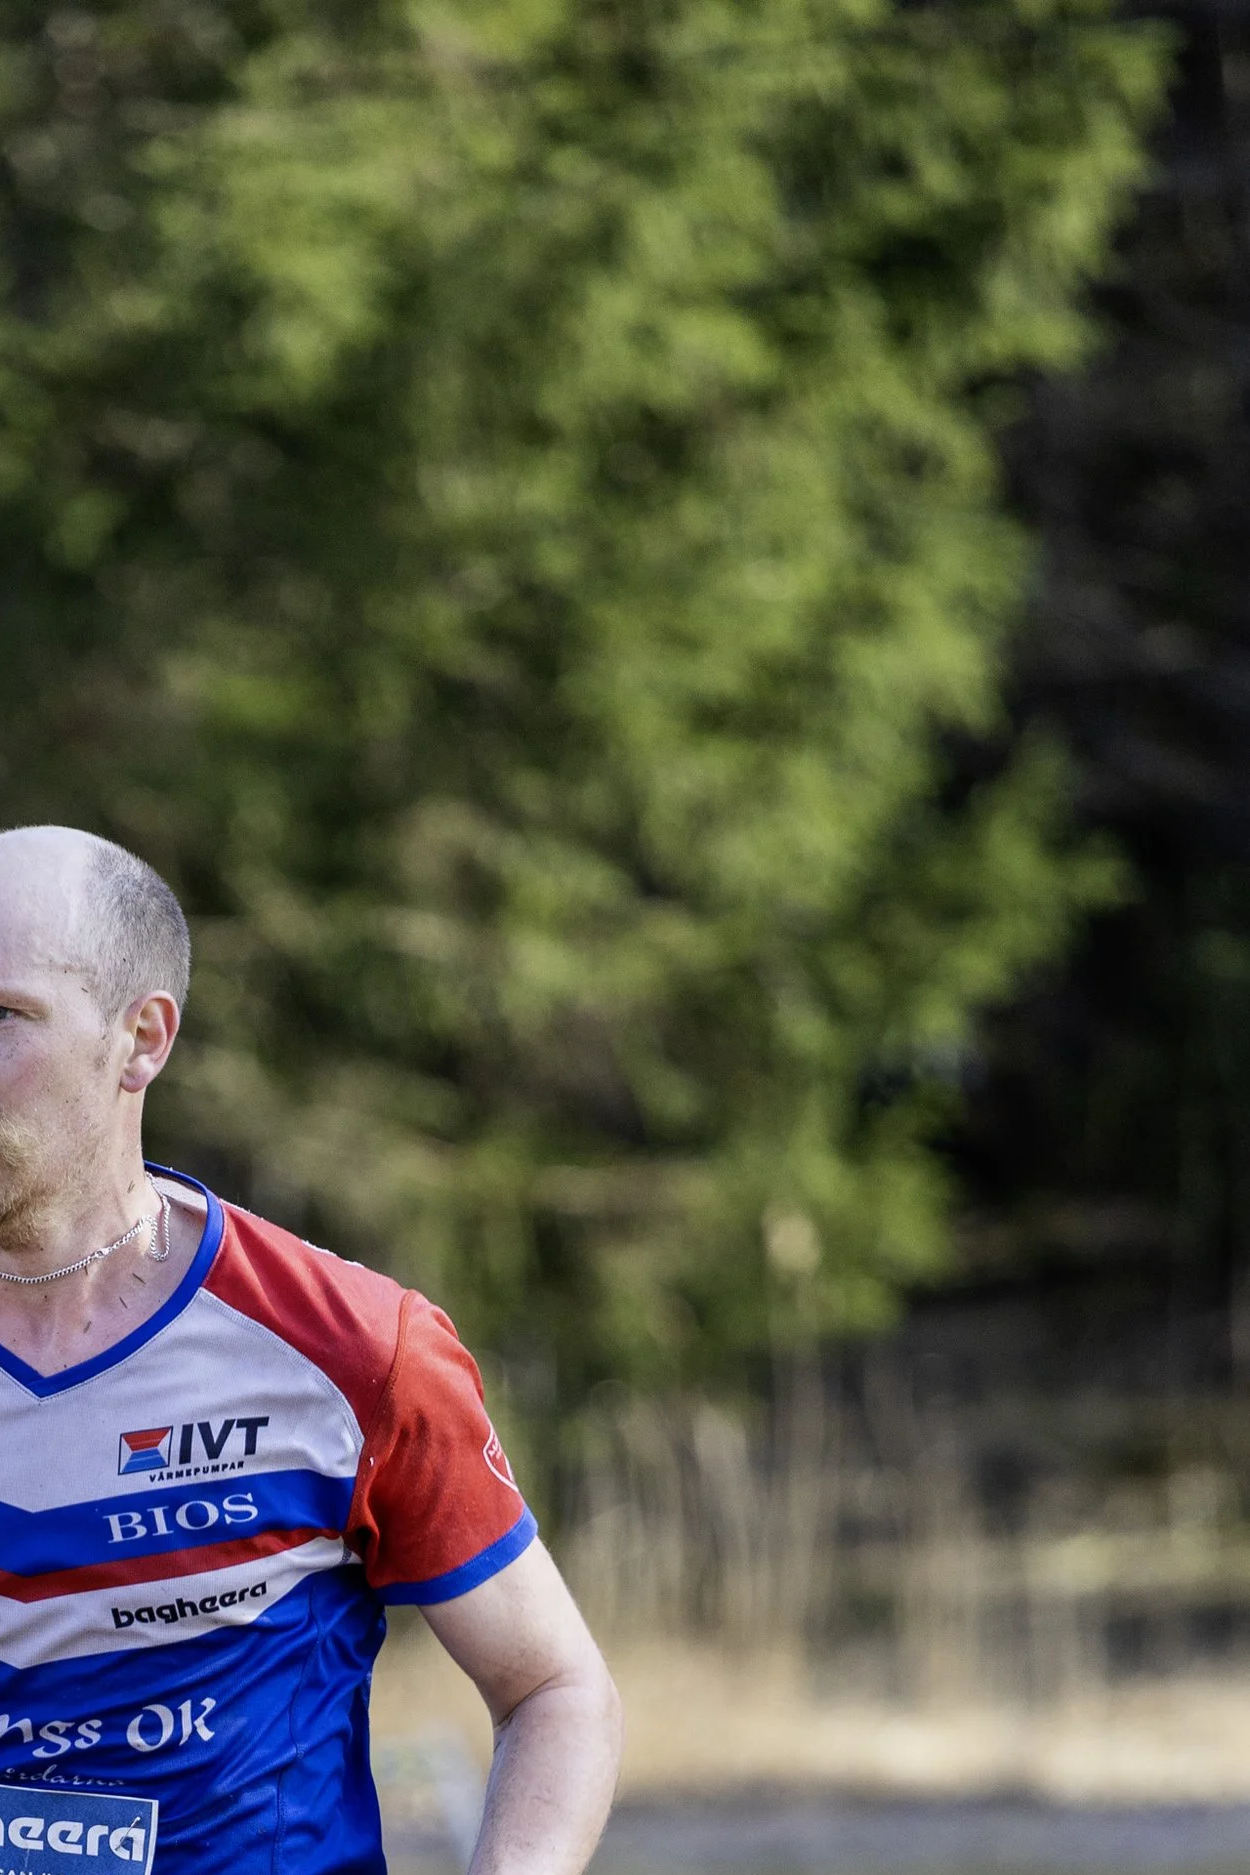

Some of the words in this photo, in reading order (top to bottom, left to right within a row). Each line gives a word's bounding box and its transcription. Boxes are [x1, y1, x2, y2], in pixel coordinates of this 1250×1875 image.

[179, 1416, 270, 1465] IVT
[102, 1493, 258, 1544] BIOS
[111, 1581, 267, 1629] bagheera
[126, 1697, 217, 1753] OK
